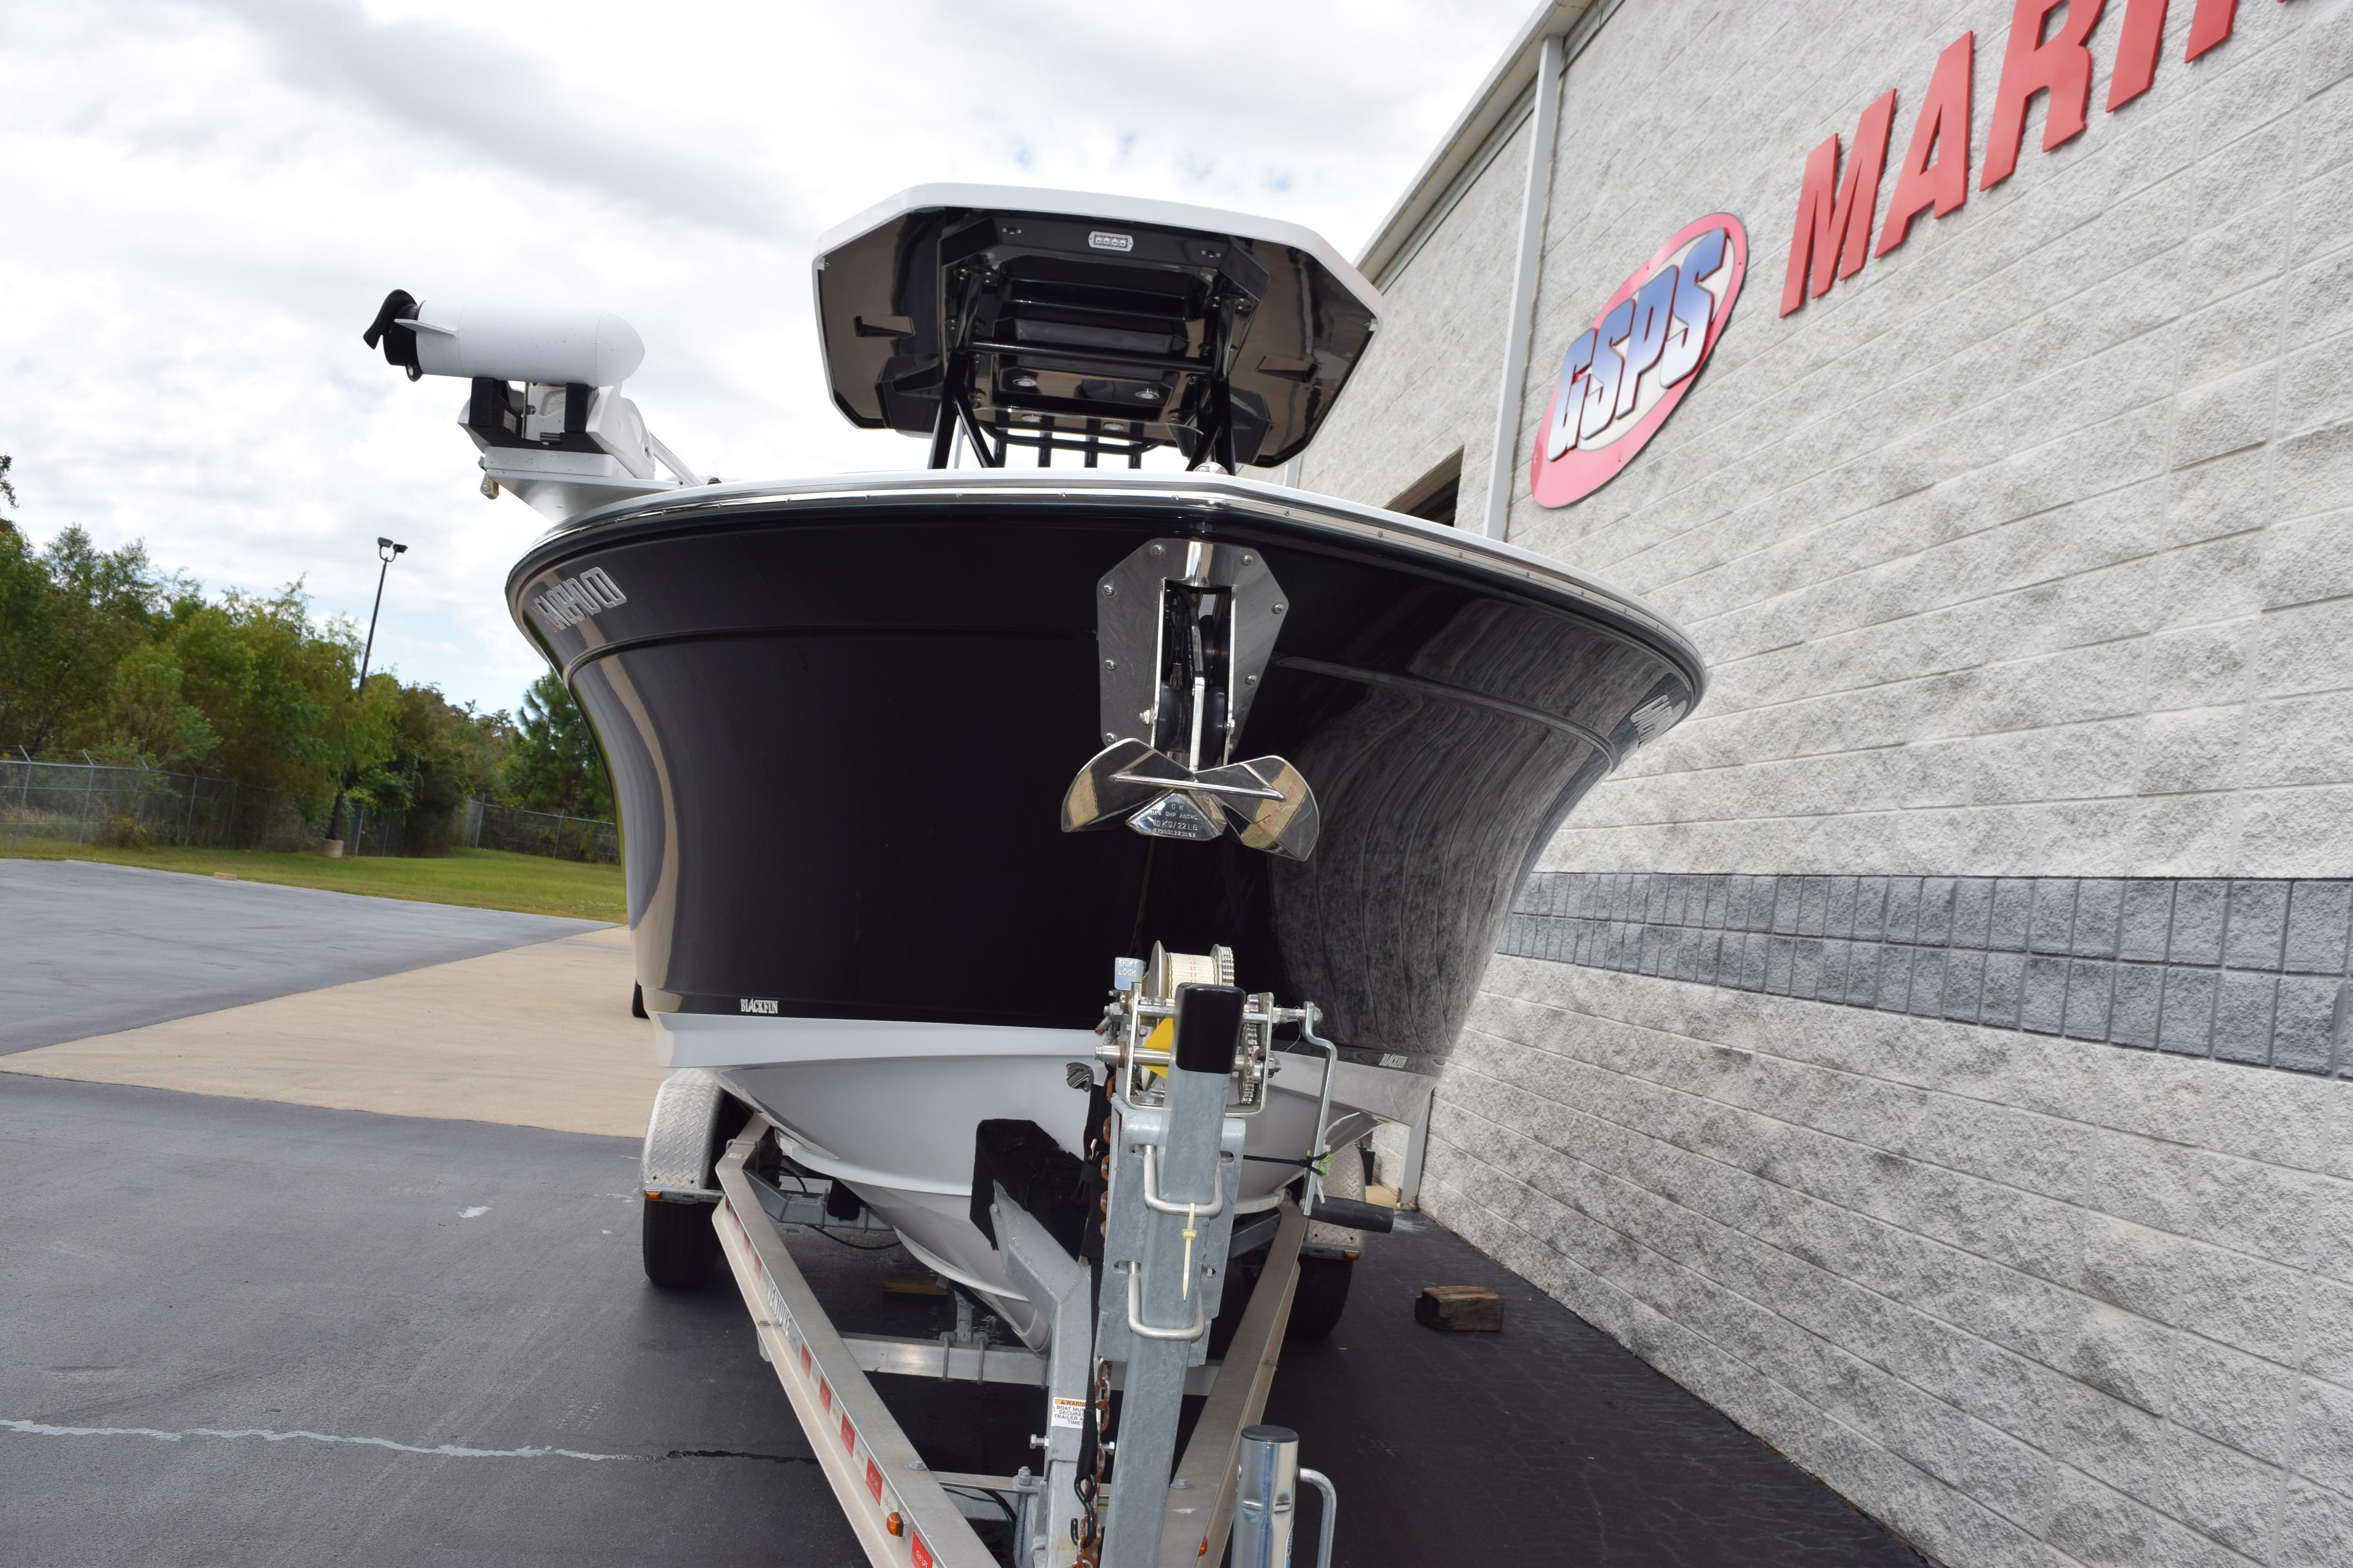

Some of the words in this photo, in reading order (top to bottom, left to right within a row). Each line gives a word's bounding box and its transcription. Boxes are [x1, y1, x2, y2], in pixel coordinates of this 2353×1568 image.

[1548, 227, 1728, 463] GSPS
[1118, 959, 1138, 967] SHIFT
[740, 998, 778, 1014] BLACKFIN
[767, 1279, 791, 1338] VENTURE
